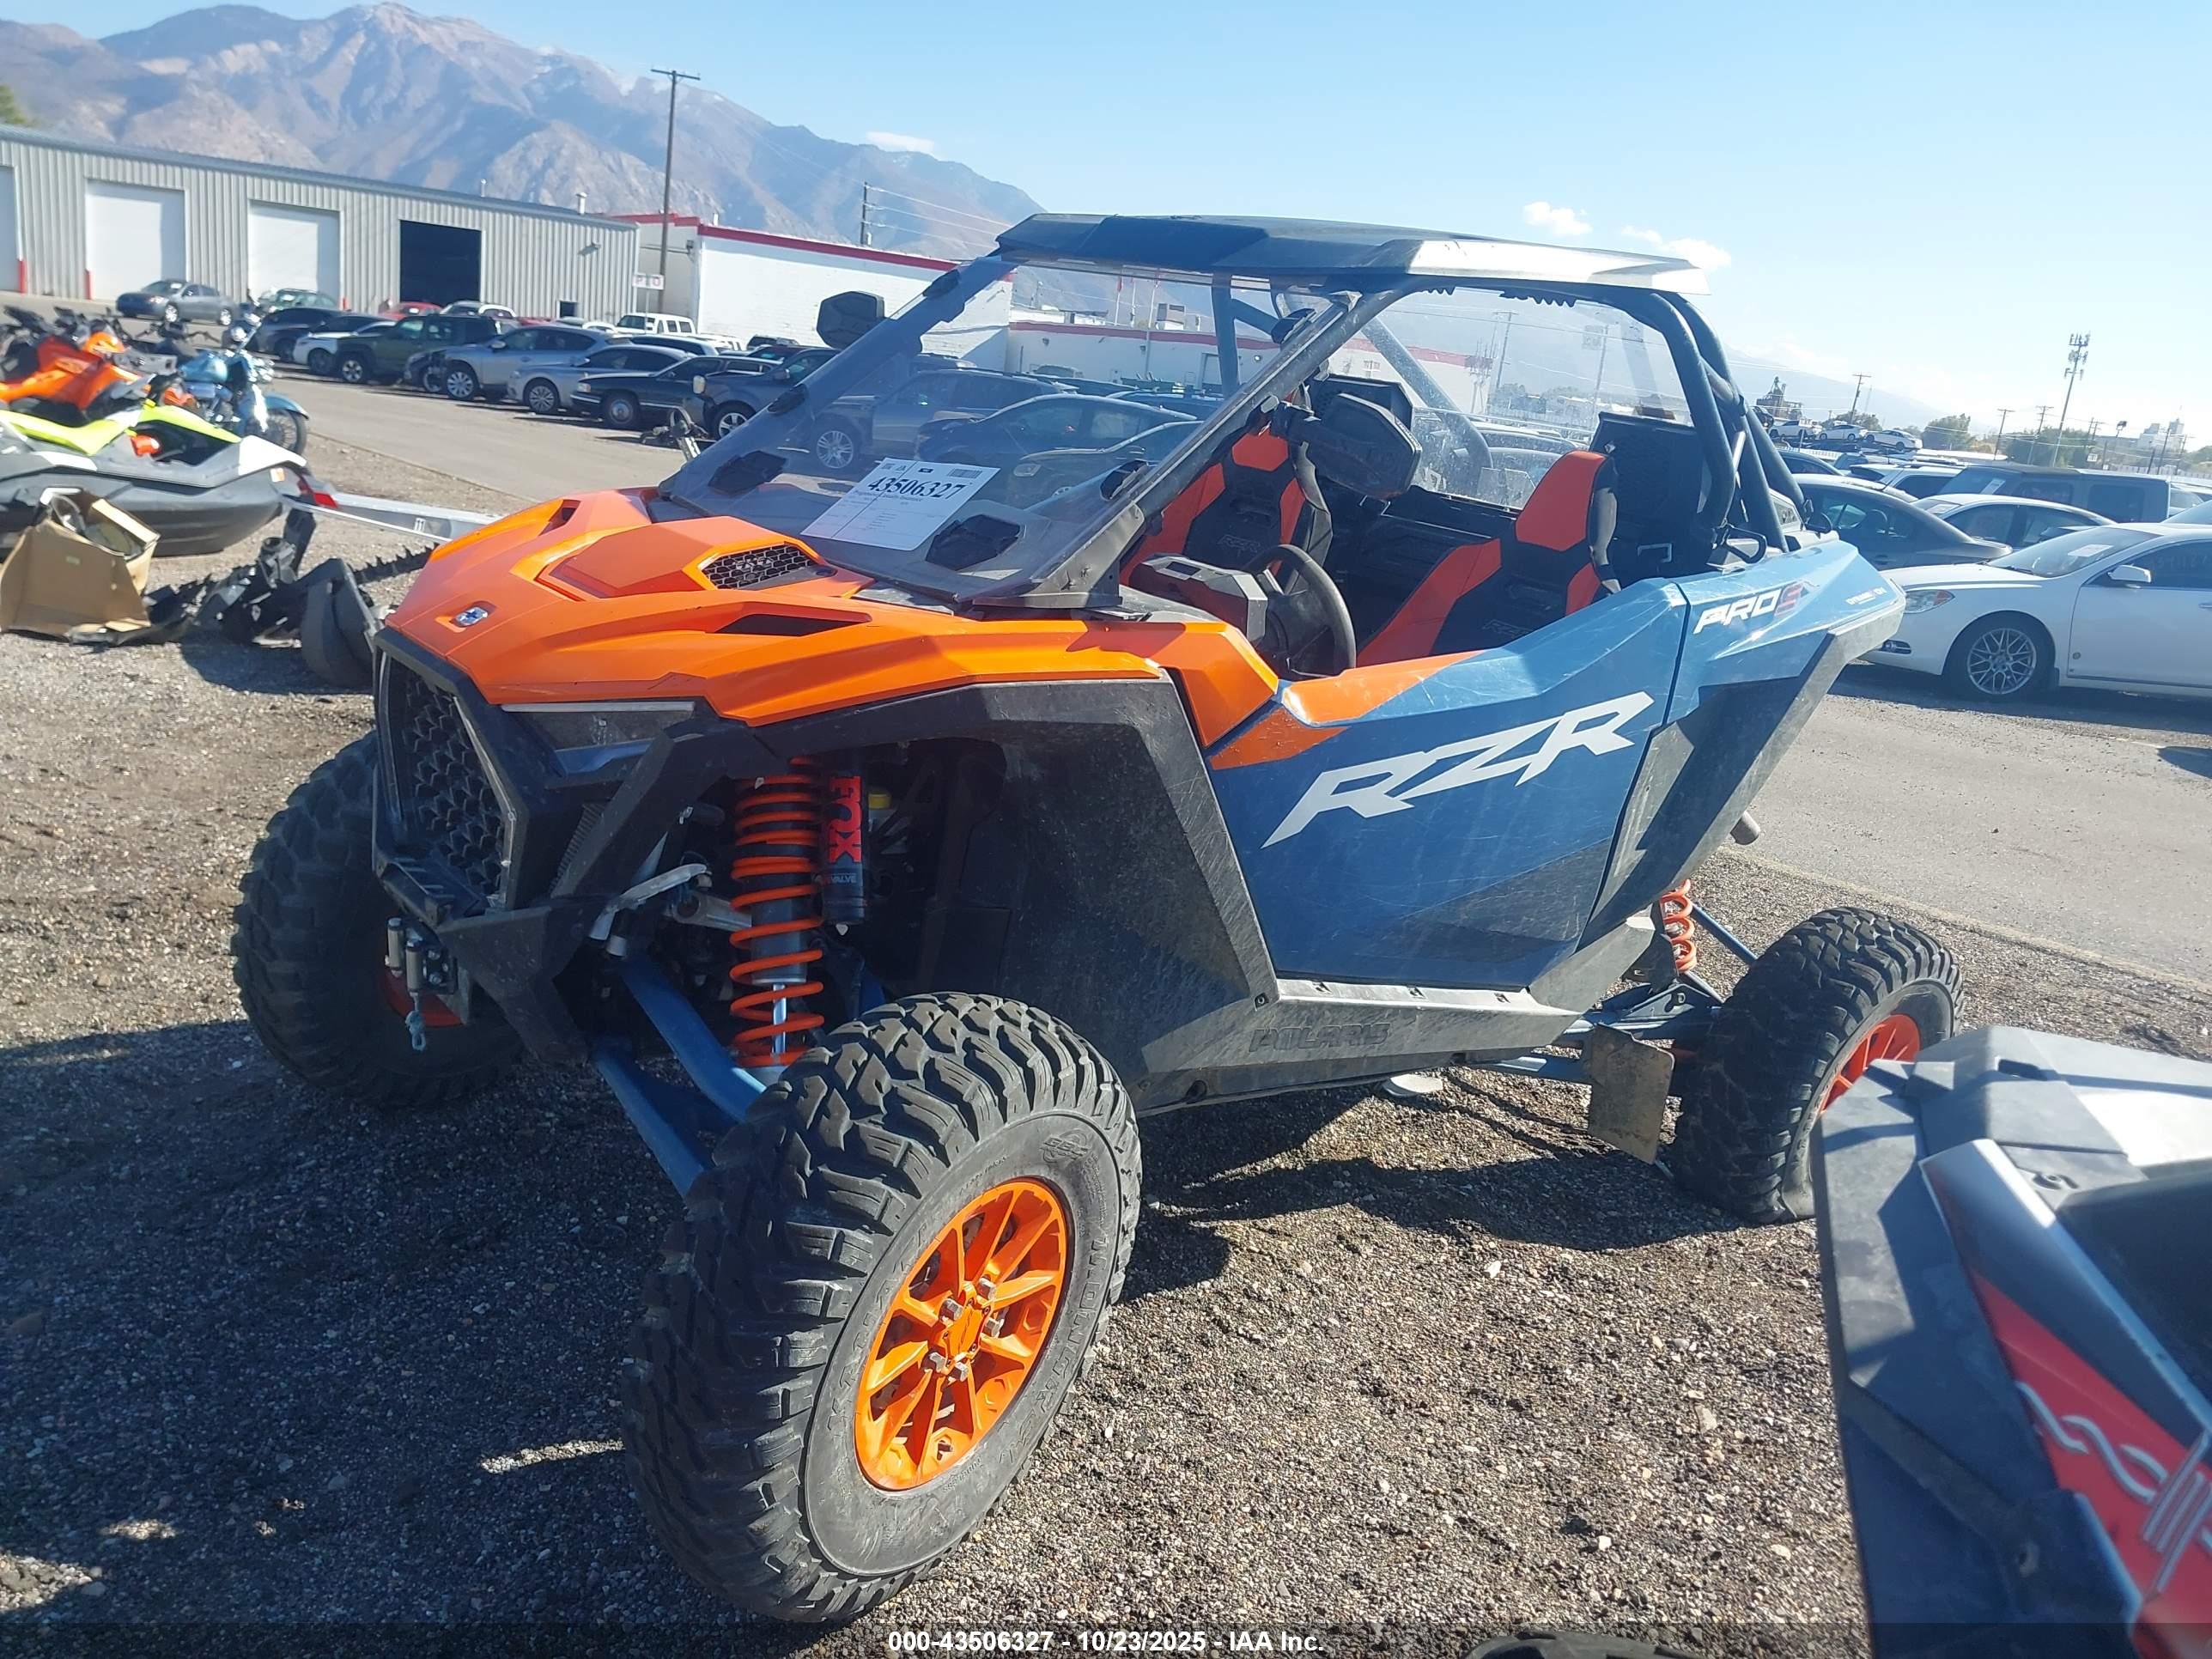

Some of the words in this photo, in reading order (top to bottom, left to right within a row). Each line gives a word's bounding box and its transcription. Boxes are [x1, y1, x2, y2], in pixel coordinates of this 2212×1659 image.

[867, 476, 968, 500] 43506327
[1261, 690, 1655, 849] RZR
[829, 775, 862, 864] FOX
[1249, 1022, 1391, 1053] POLARIS
